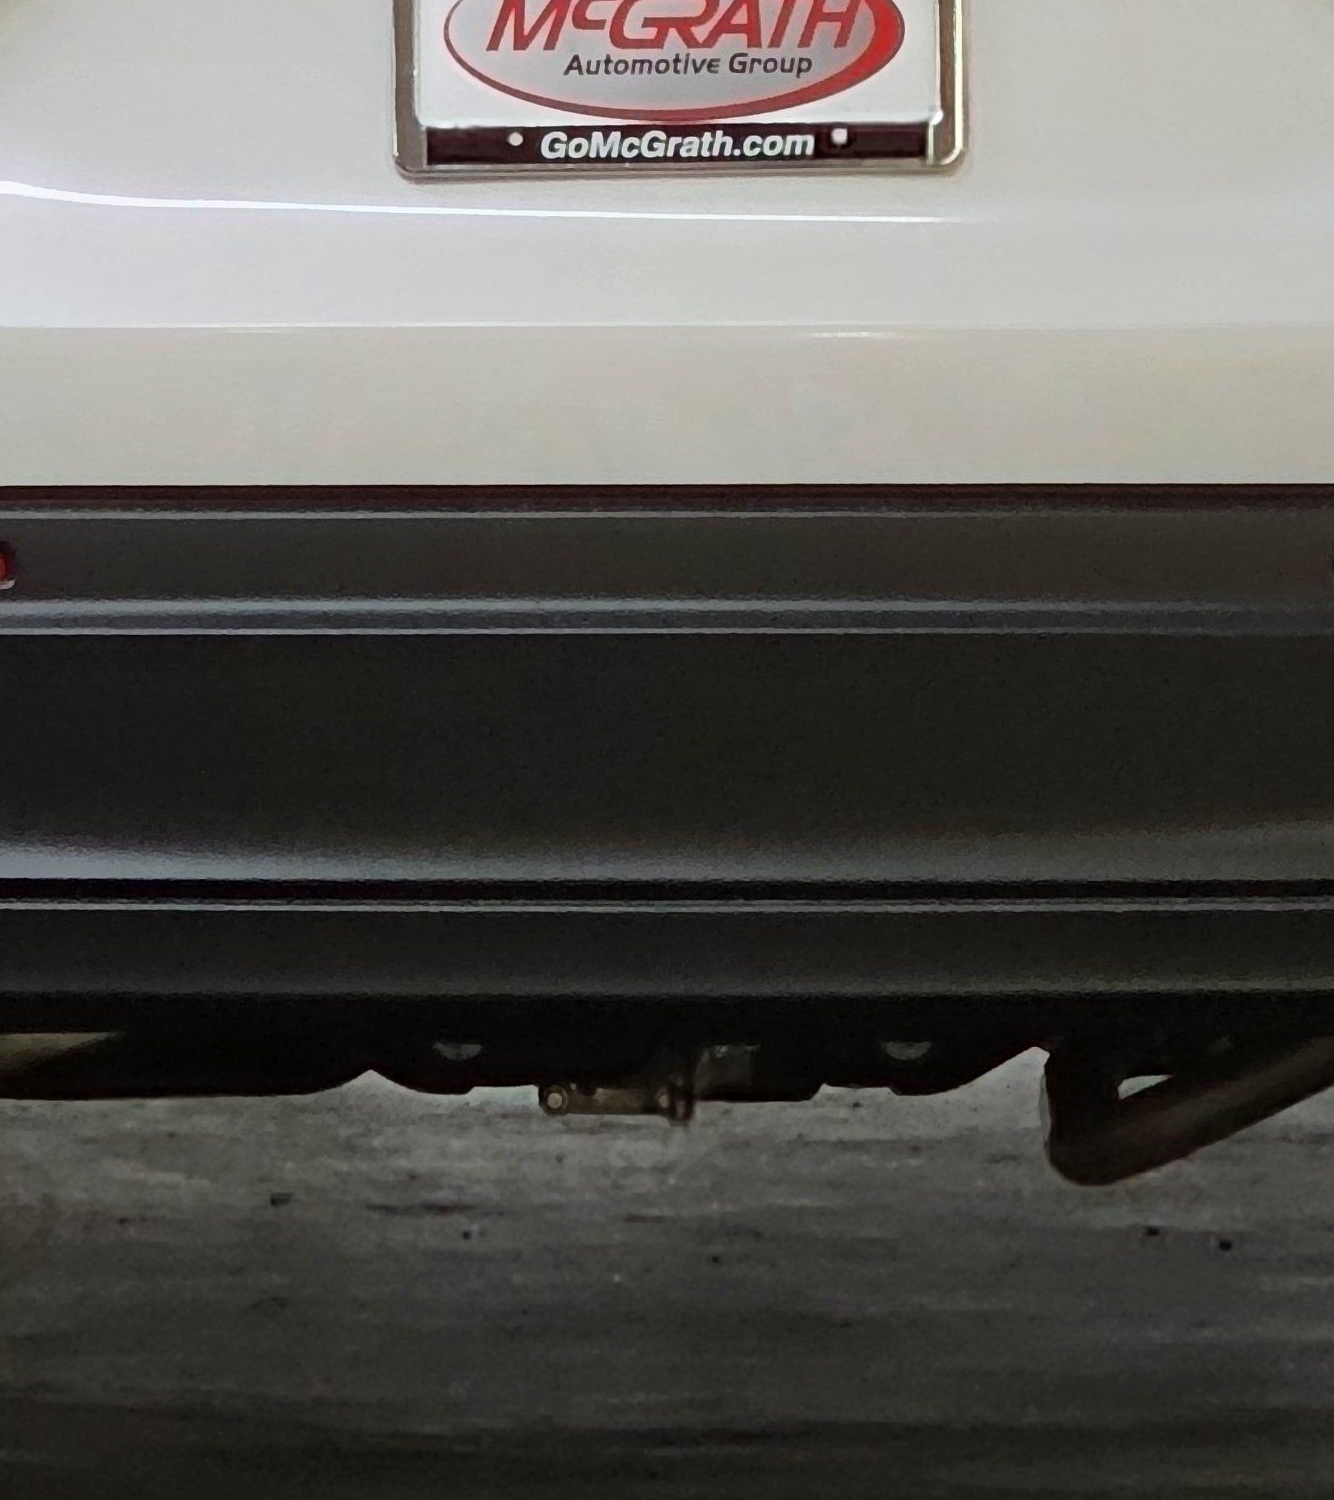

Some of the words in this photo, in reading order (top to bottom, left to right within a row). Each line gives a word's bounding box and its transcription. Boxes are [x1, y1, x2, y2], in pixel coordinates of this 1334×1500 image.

[564, 54, 720, 77] Automotive
[730, 53, 813, 78] Group
[540, 130, 815, 160] GoMcGrath.com
